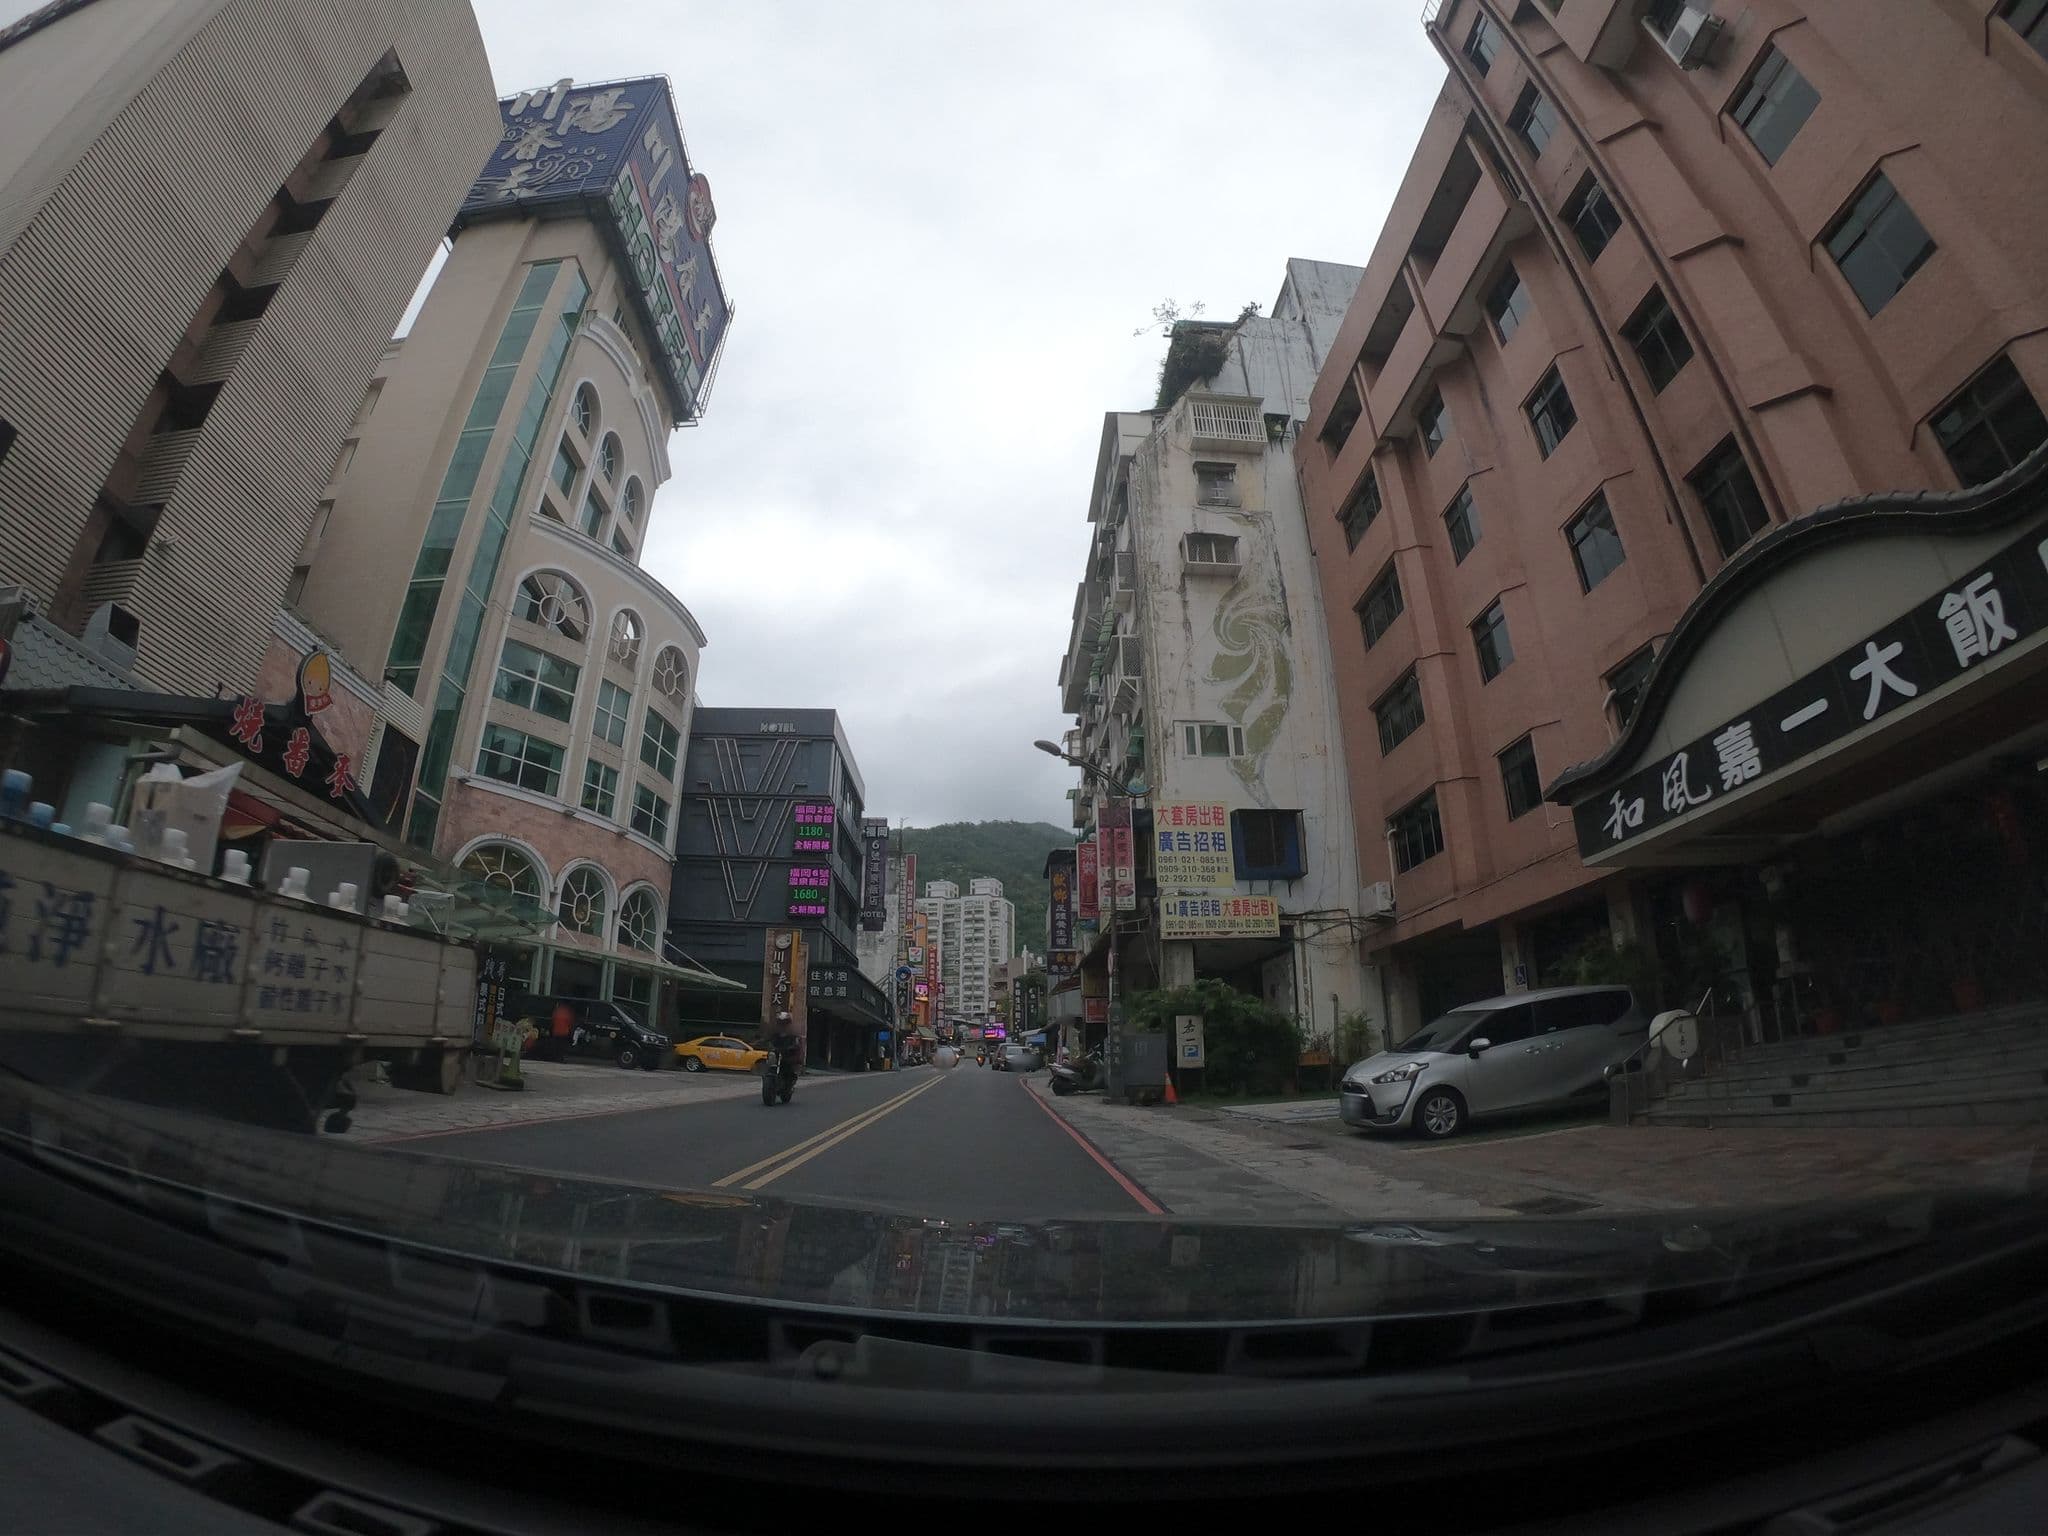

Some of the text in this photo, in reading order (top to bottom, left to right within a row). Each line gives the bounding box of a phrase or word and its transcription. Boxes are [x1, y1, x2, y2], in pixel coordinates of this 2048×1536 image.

[613, 170, 699, 396] HOTEL
[1603, 536, 2048, 840] 和風嘉一大飯
[1157, 805, 1225, 826] 大套房出租
[799, 826, 823, 836] 1180
[1159, 831, 1226, 852] 廣告招租
[793, 889, 818, 899] 1680
[1179, 899, 1269, 917] 廣告招租 大套房出租
[770, 951, 791, 1005] 川湯春天
